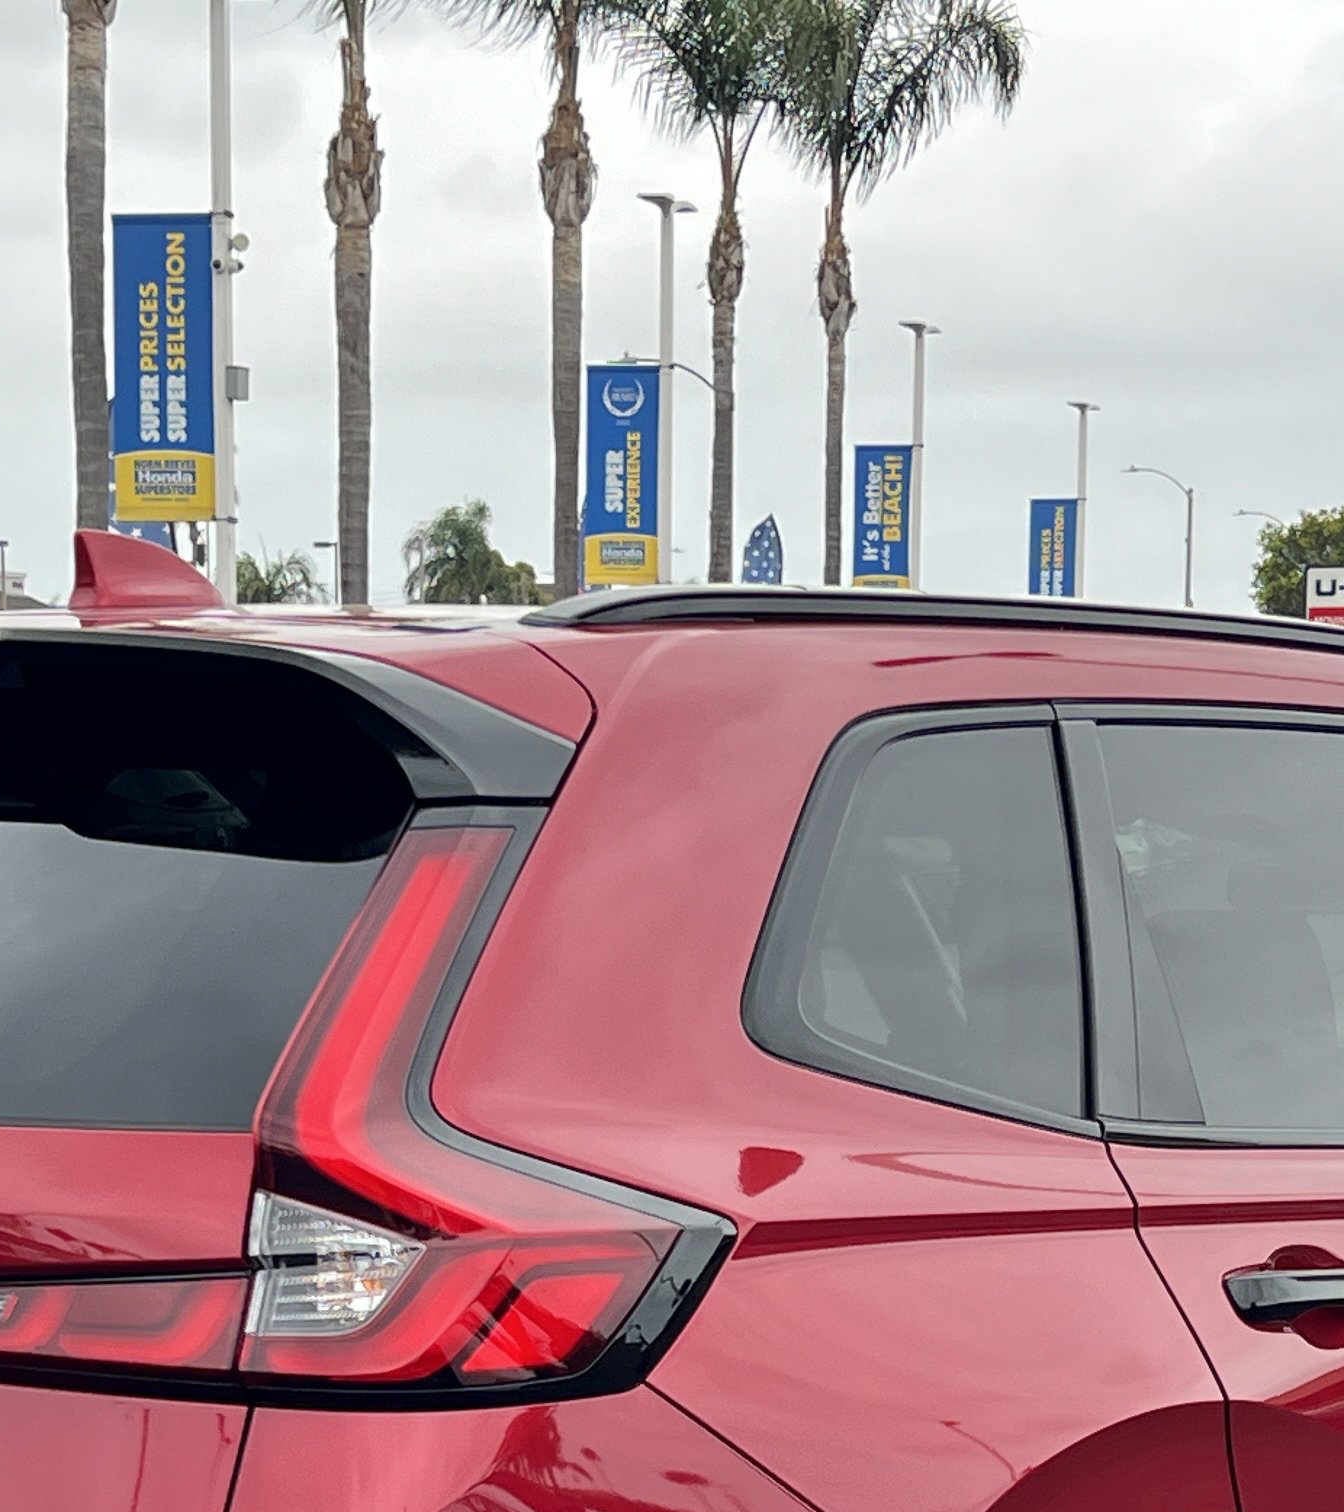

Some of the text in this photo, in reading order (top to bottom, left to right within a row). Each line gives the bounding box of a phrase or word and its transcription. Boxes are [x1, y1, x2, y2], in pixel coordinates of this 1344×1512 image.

[138, 281, 161, 444] SUPER PRICES
[164, 231, 188, 444] SUPER SELECTION
[137, 469, 195, 484] Honda
[603, 449, 625, 514] SUPER
[625, 430, 642, 529] EXPERIENCE
[862, 461, 884, 525] Better
[861, 528, 881, 562] It's
